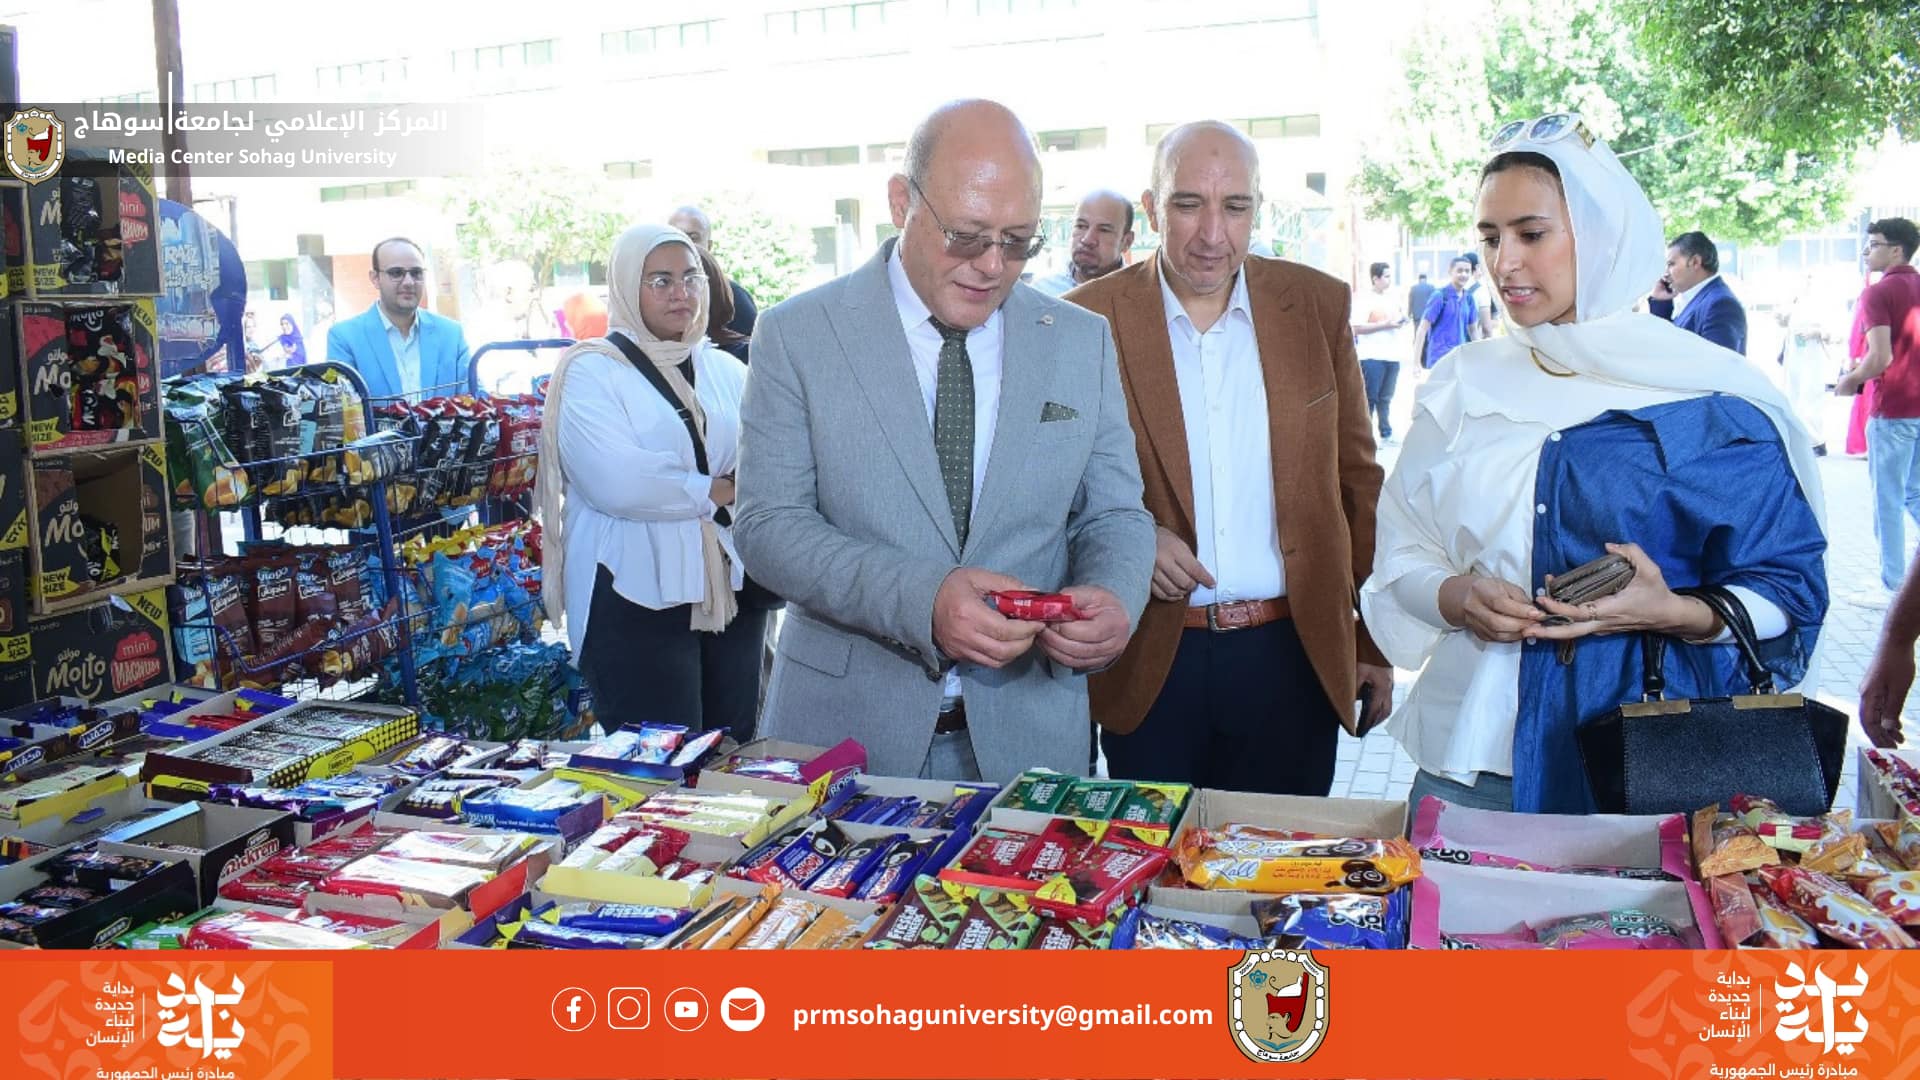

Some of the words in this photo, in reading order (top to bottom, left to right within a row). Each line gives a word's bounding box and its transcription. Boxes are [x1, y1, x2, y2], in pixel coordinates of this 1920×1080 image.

[43, 572, 66, 583] NEW
[42, 583, 65, 594] SIZE
[137, 595, 163, 621] NEW
[122, 639, 151, 656] mini
[46, 652, 107, 694] Molto
[113, 659, 161, 688] MAGNUM
